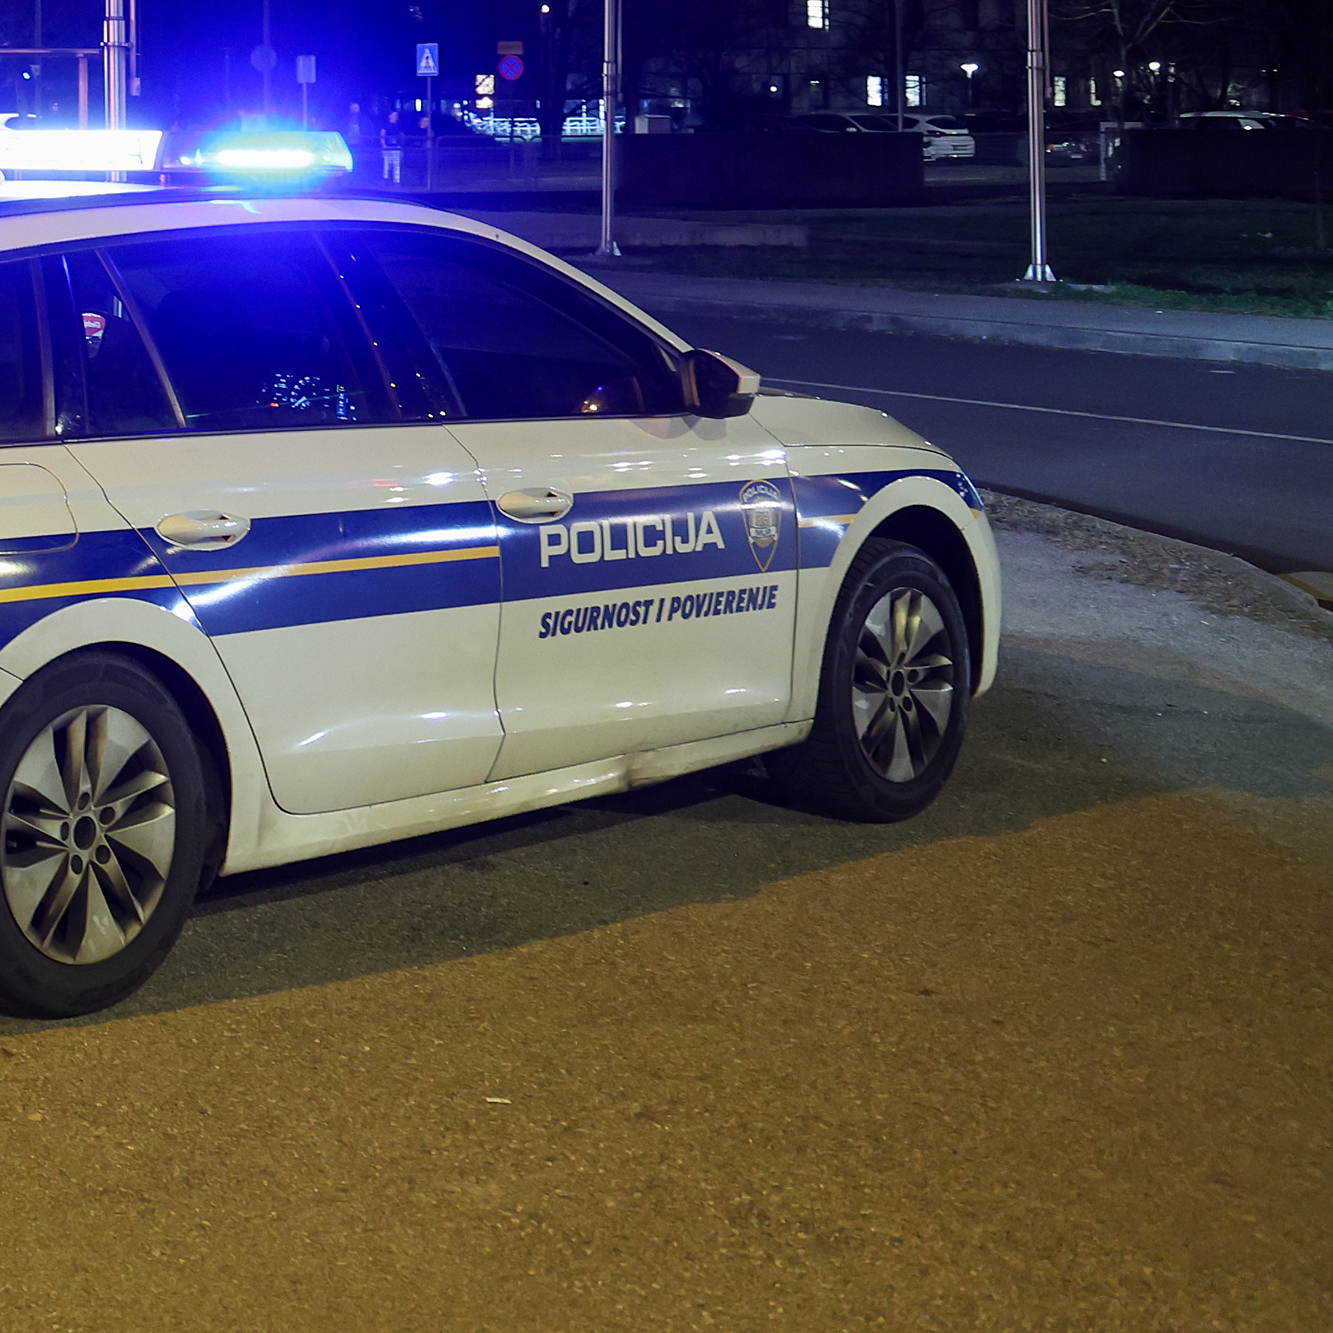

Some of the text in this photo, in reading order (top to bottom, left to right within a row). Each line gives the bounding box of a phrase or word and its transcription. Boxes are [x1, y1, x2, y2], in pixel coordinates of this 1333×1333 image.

[539, 510, 726, 568] POLICIJA
[538, 584, 779, 640] SIGURNOST I POVJERENJE
